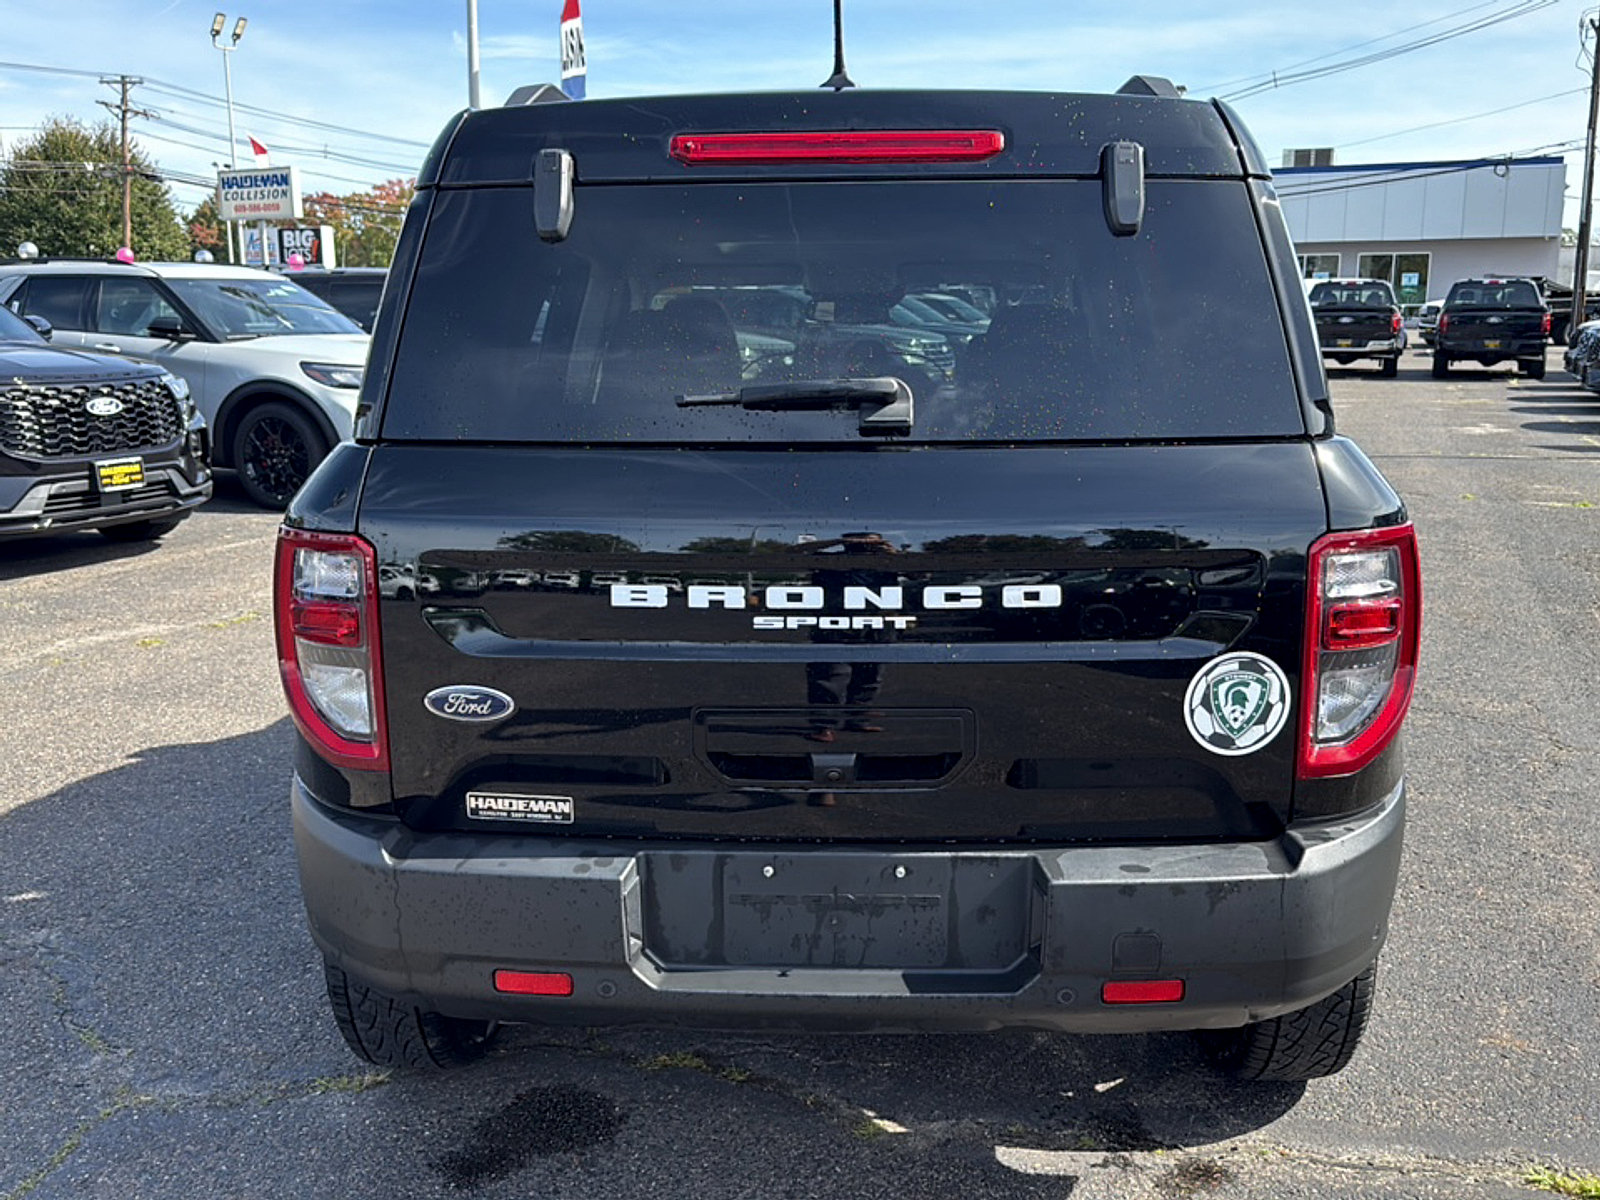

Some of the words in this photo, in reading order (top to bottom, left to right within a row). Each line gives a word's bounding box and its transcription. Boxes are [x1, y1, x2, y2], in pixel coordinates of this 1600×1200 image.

[221, 173, 289, 189] HALDEMAN
[224, 188, 288, 201] COLLISION
[283, 230, 316, 247] BIG
[610, 584, 1062, 609] BRONCO
[752, 616, 917, 630] SPORT
[443, 693, 492, 715] Ford
[470, 797, 570, 813] HALDEMAN
